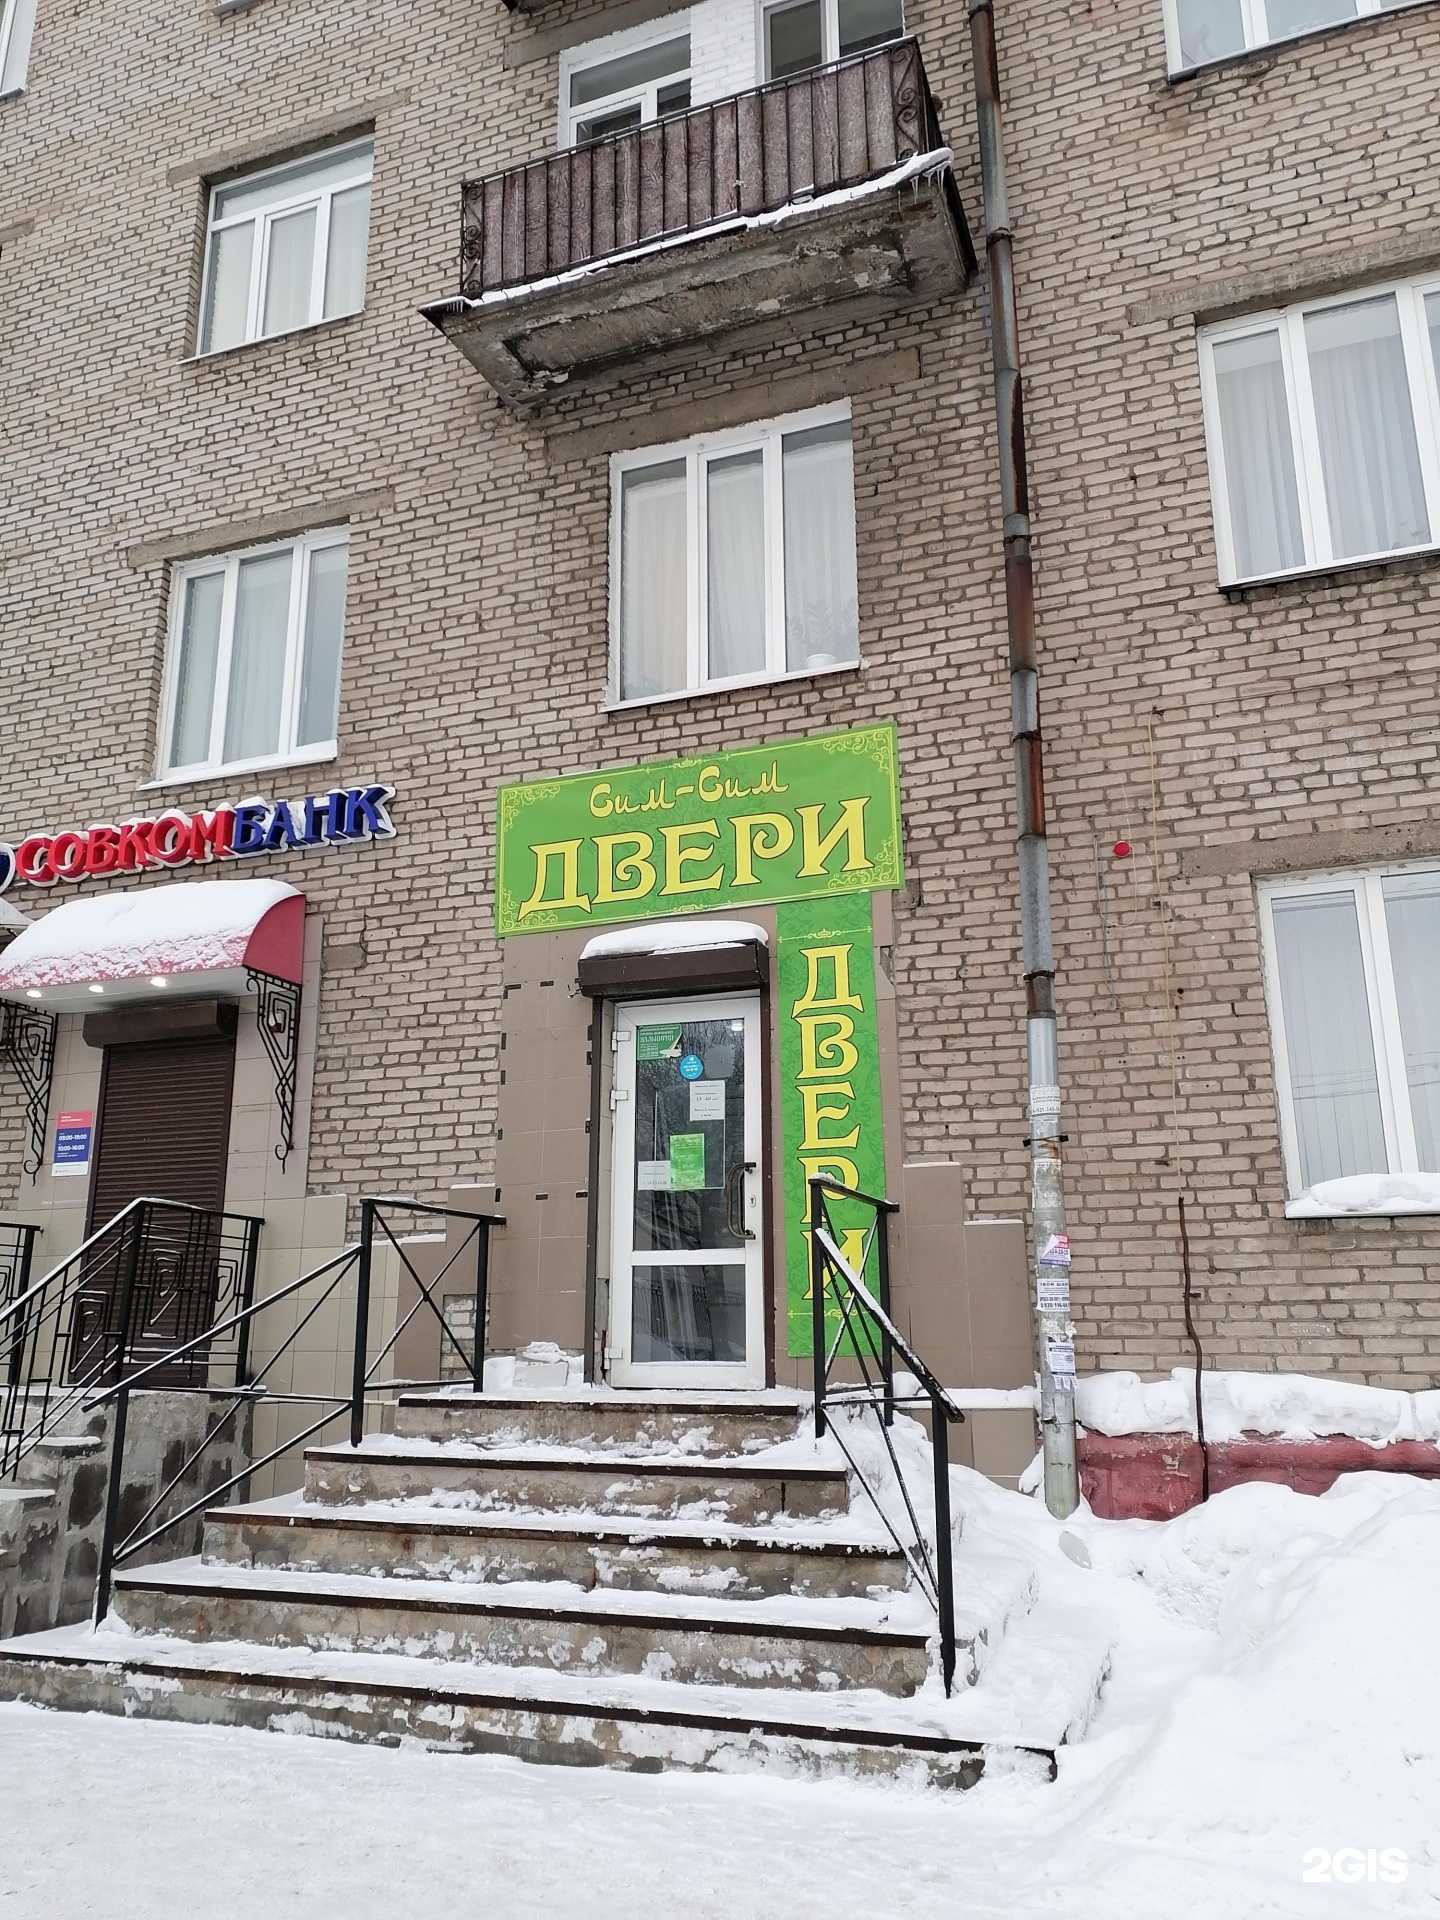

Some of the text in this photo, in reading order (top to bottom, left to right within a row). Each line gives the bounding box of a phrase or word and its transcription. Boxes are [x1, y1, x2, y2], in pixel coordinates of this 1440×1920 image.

[15, 783, 398, 887] СОВКОМБАНК
[590, 760, 789, 818] Сим-Сим
[516, 796, 876, 922] ДВЕРИ
